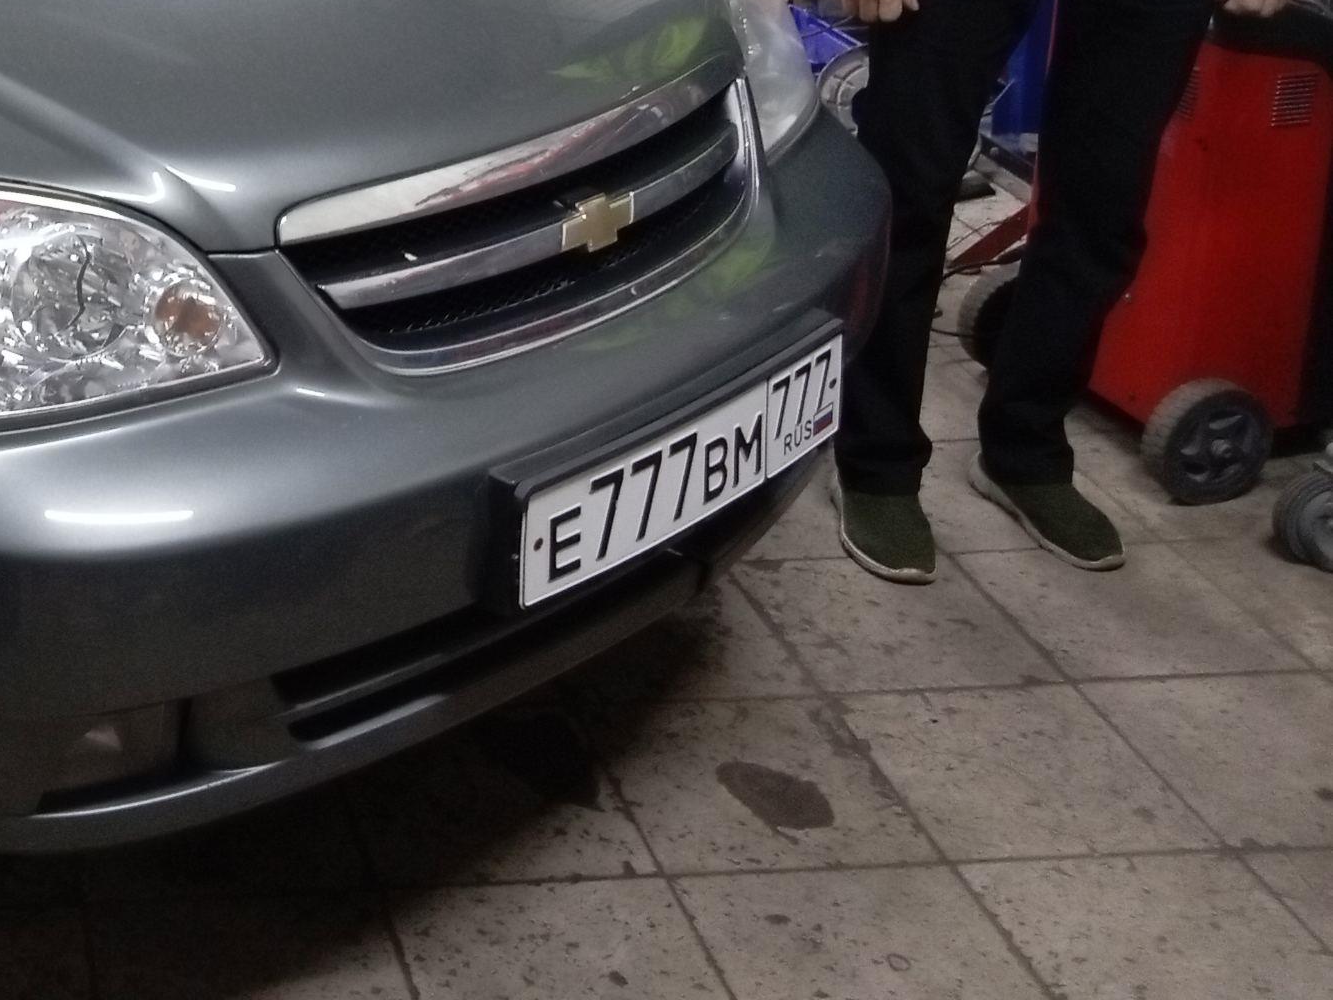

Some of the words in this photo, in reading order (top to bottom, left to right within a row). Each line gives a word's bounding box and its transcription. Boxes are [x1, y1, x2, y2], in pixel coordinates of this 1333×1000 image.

[548, 412, 763, 582] E777BM
[771, 349, 832, 439] 777
[783, 420, 813, 456] RUS
